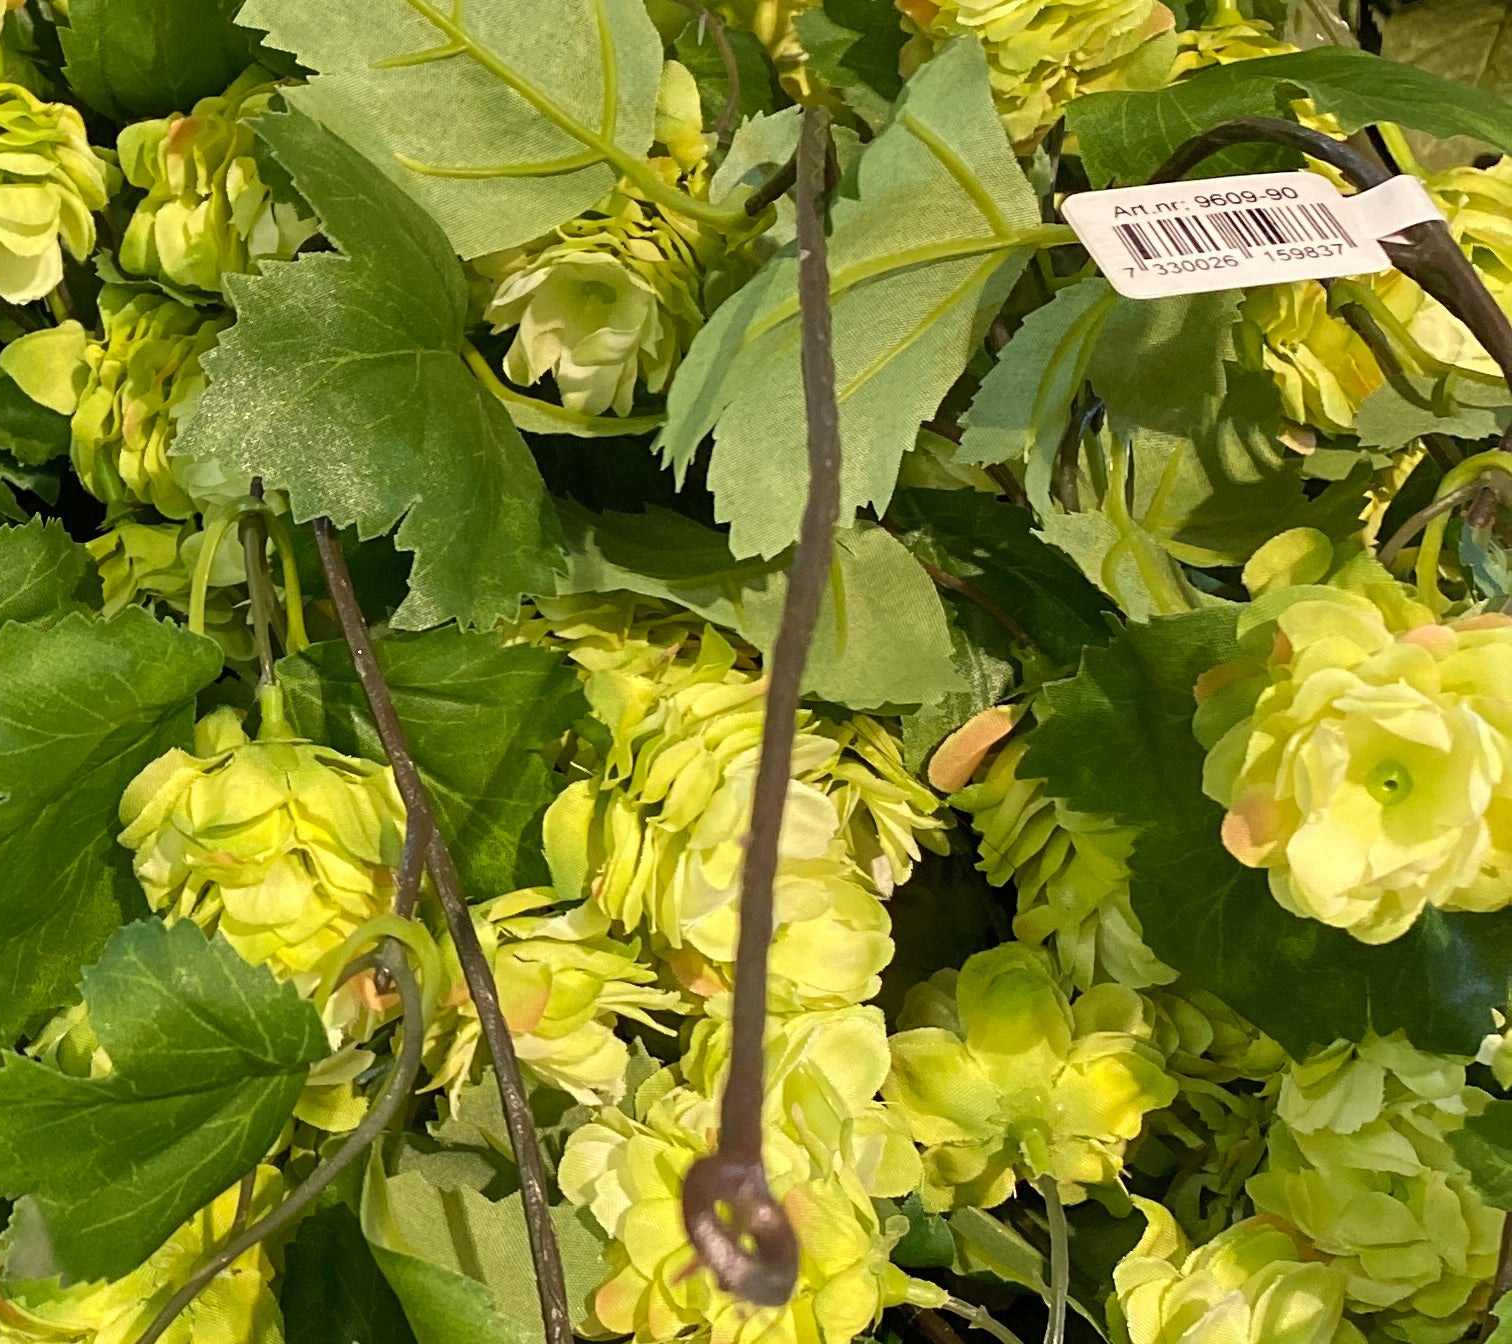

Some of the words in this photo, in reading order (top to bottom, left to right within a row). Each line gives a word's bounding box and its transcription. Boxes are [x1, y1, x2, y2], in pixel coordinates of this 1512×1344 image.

[1114, 199, 1190, 219] Art.nr:
[1194, 187, 1299, 208] 9609-90
[1123, 267, 1135, 279] 7
[1155, 254, 1239, 276] 330026
[1264, 243, 1345, 263] 159837
